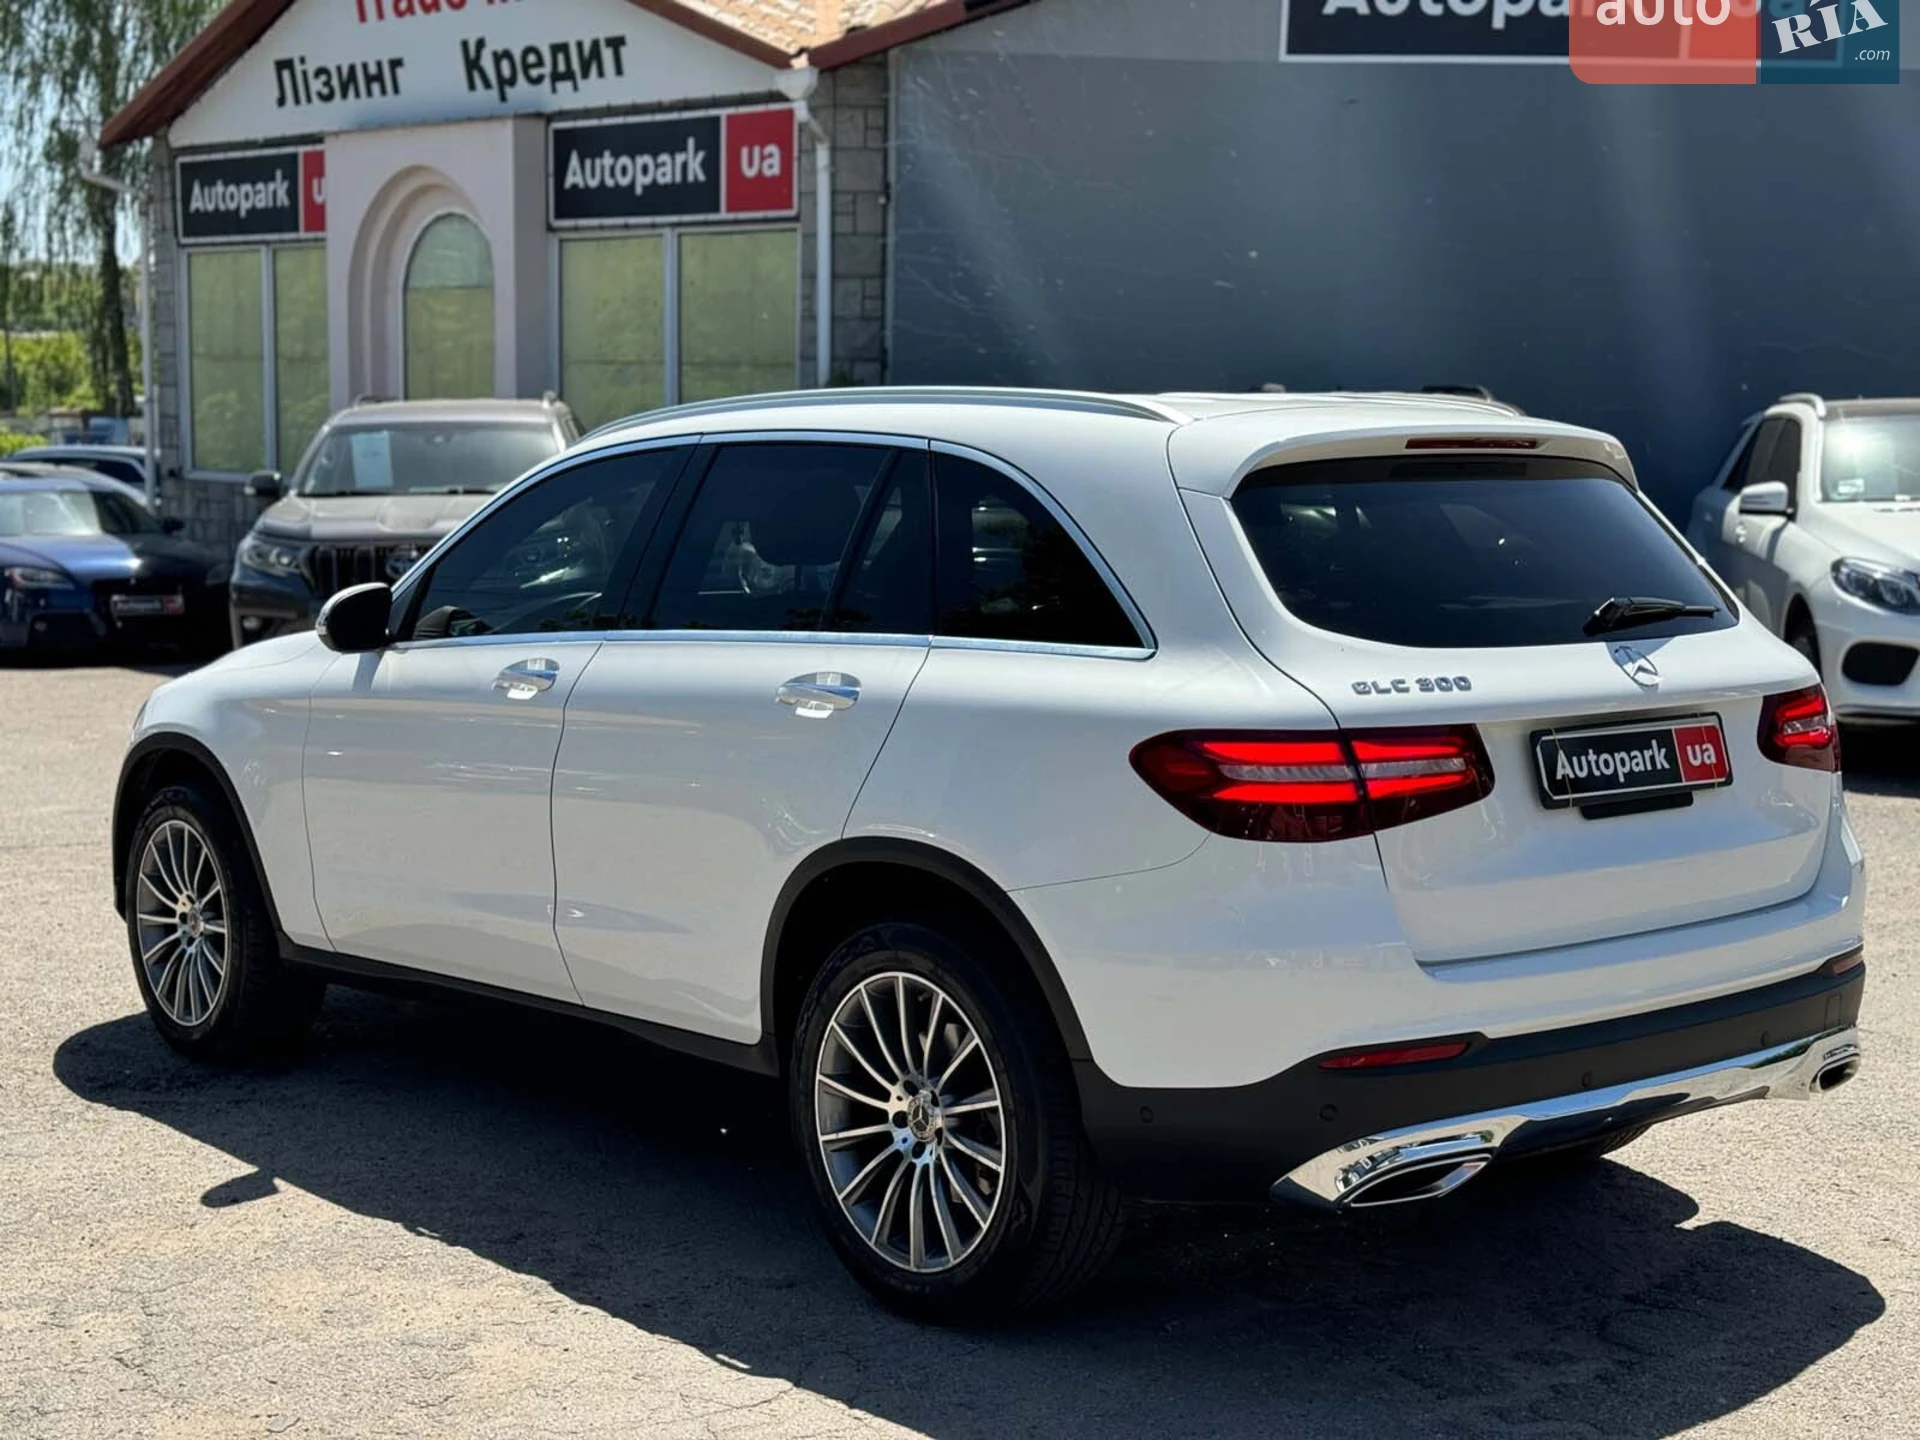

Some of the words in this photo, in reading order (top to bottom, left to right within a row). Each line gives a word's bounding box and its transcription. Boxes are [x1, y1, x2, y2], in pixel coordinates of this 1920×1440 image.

[274, 55, 405, 108] Лізинг
[460, 36, 628, 103] Кредит
[563, 136, 707, 196] Autopark
[740, 143, 781, 179] ua
[189, 168, 290, 219] Autopark
[312, 177, 326, 204] u
[1351, 679, 1410, 695] GLC
[1415, 675, 1472, 693] 300
[1556, 739, 1670, 783] Autopark
[1686, 742, 1717, 767] ua
